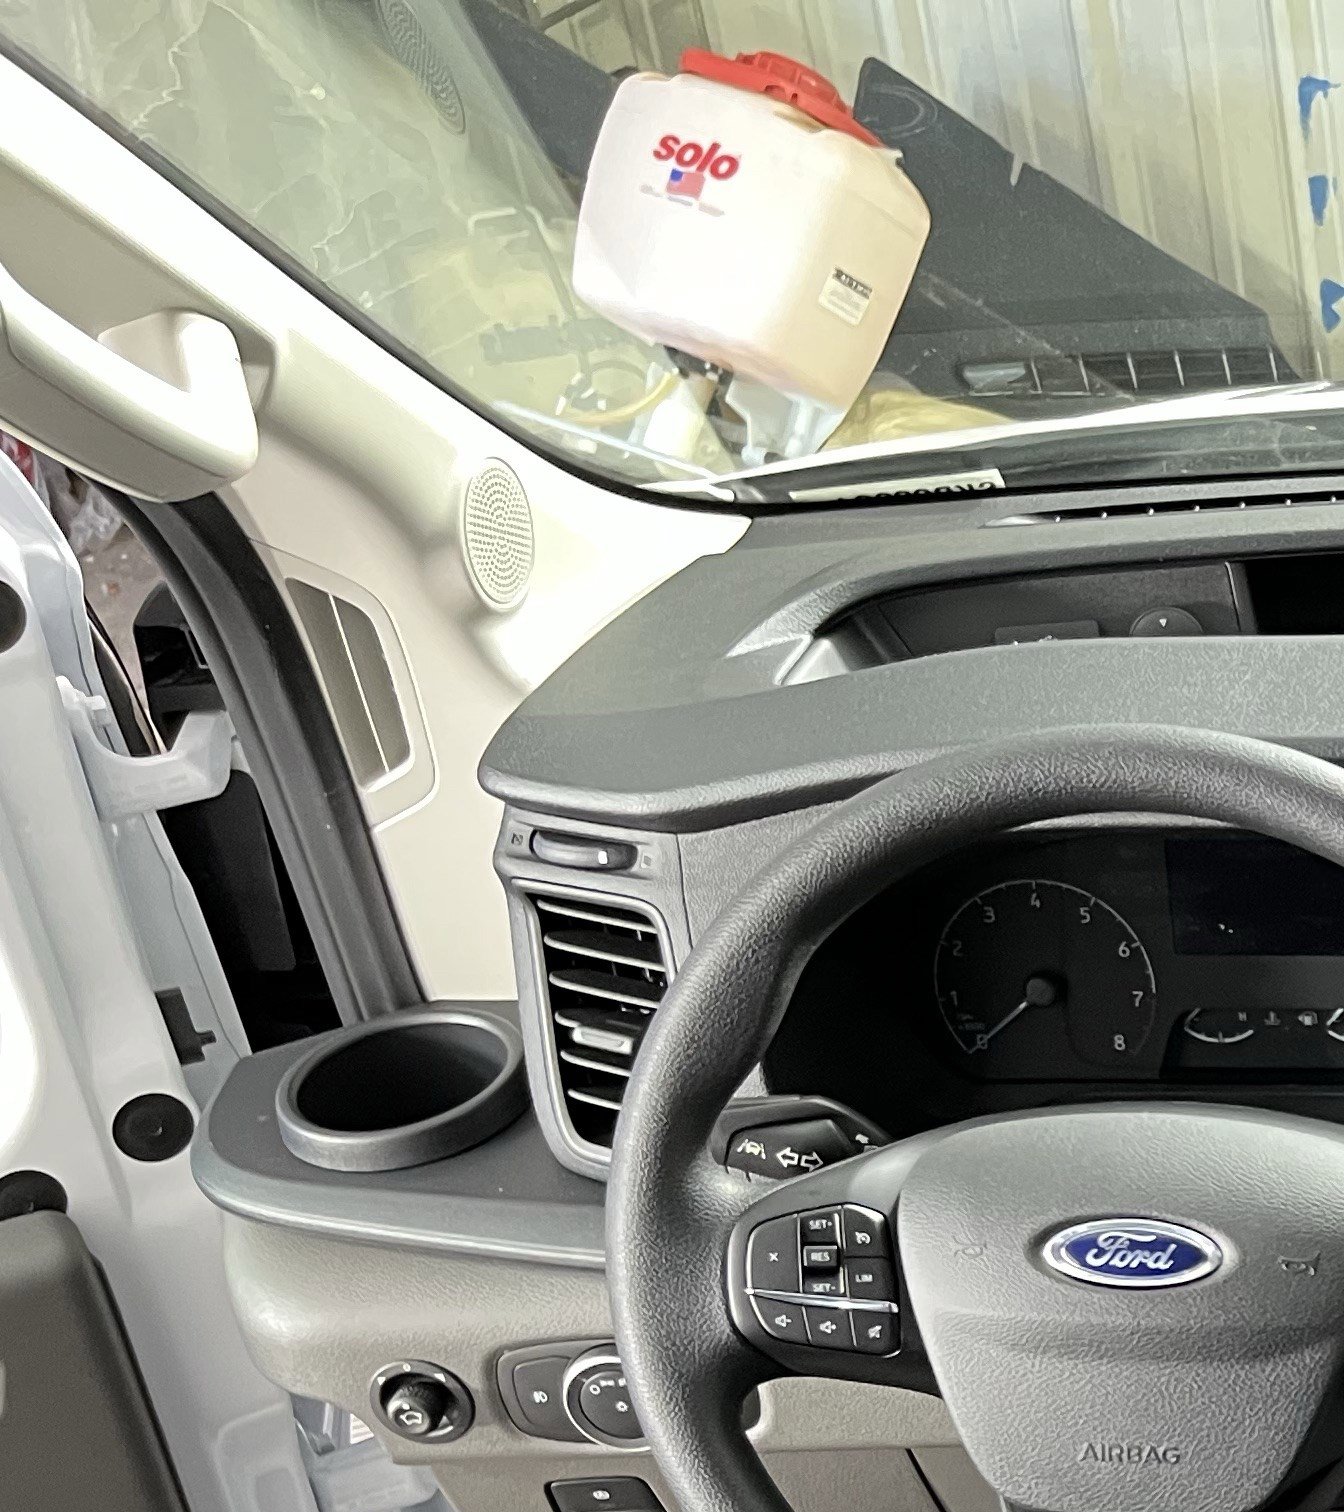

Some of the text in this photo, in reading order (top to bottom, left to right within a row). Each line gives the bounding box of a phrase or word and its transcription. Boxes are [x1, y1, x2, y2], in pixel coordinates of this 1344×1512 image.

[653, 134, 740, 181] solo
[1030, 893, 1040, 908] 4
[983, 907, 996, 923] 3
[1080, 907, 1091, 924] 5
[953, 941, 963, 956] 2
[1118, 941, 1130, 958] 6
[949, 991, 959, 1006] 1
[1132, 990, 1144, 1008] 7
[1113, 1035, 1126, 1051] 8
[1084, 1231, 1178, 1272] Ford
[1079, 1441, 1182, 1465] AIRBAG
